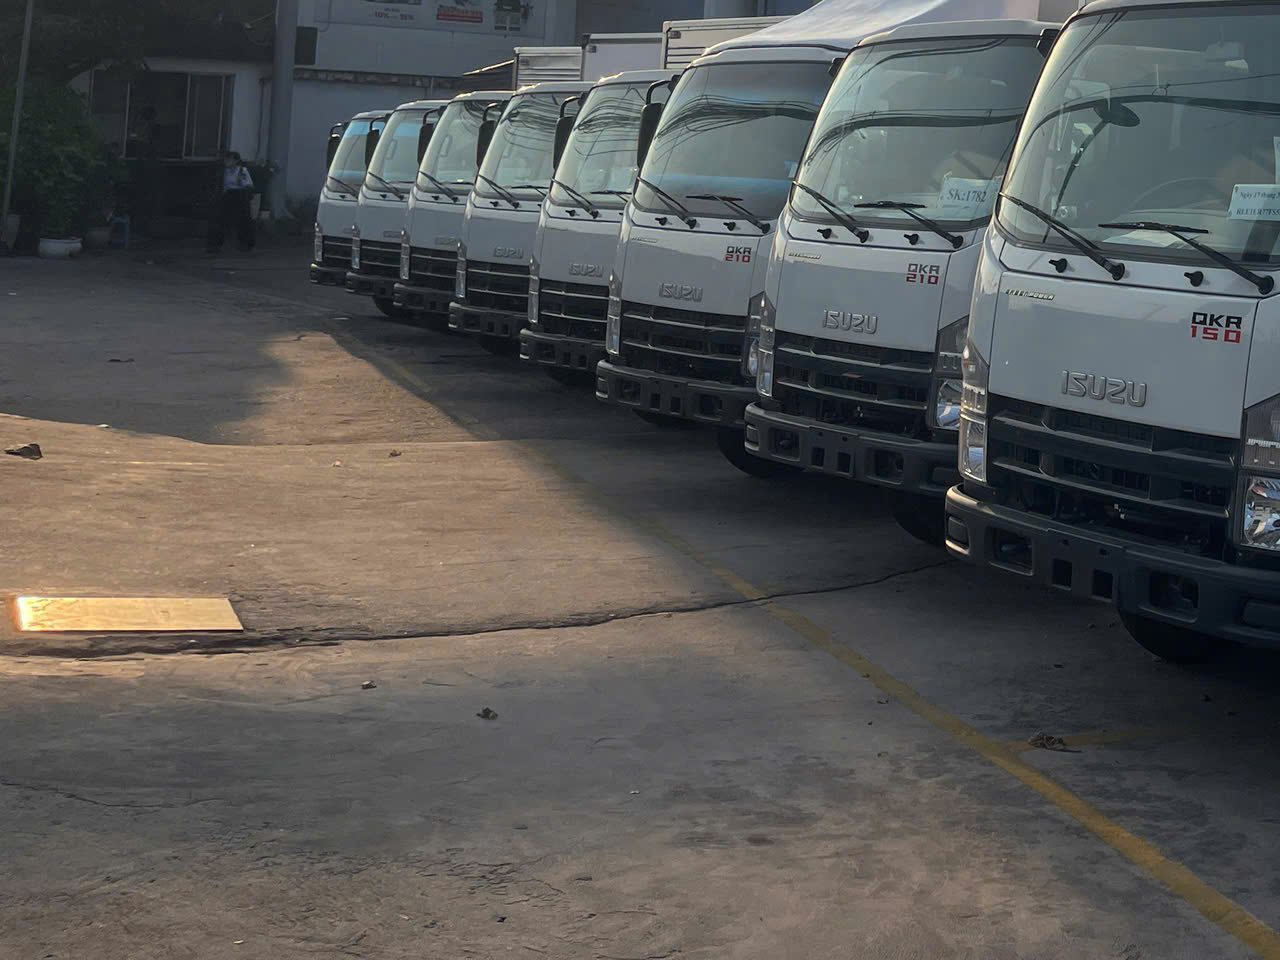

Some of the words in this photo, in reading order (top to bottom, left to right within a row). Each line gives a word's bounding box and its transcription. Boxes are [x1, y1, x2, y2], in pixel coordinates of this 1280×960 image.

[493, 247, 523, 259] ISUZU
[727, 246, 752, 255] QKR
[725, 254, 751, 263] 210
[569, 263, 605, 278] ISUZU
[907, 263, 940, 275] QKR
[906, 273, 939, 285] 210
[659, 283, 704, 303] ISUZU
[822, 309, 878, 335] ISUZU
[1192, 311, 1242, 329] QKR
[1191, 325, 1241, 343] 150
[1061, 369, 1147, 408] ISUZU
